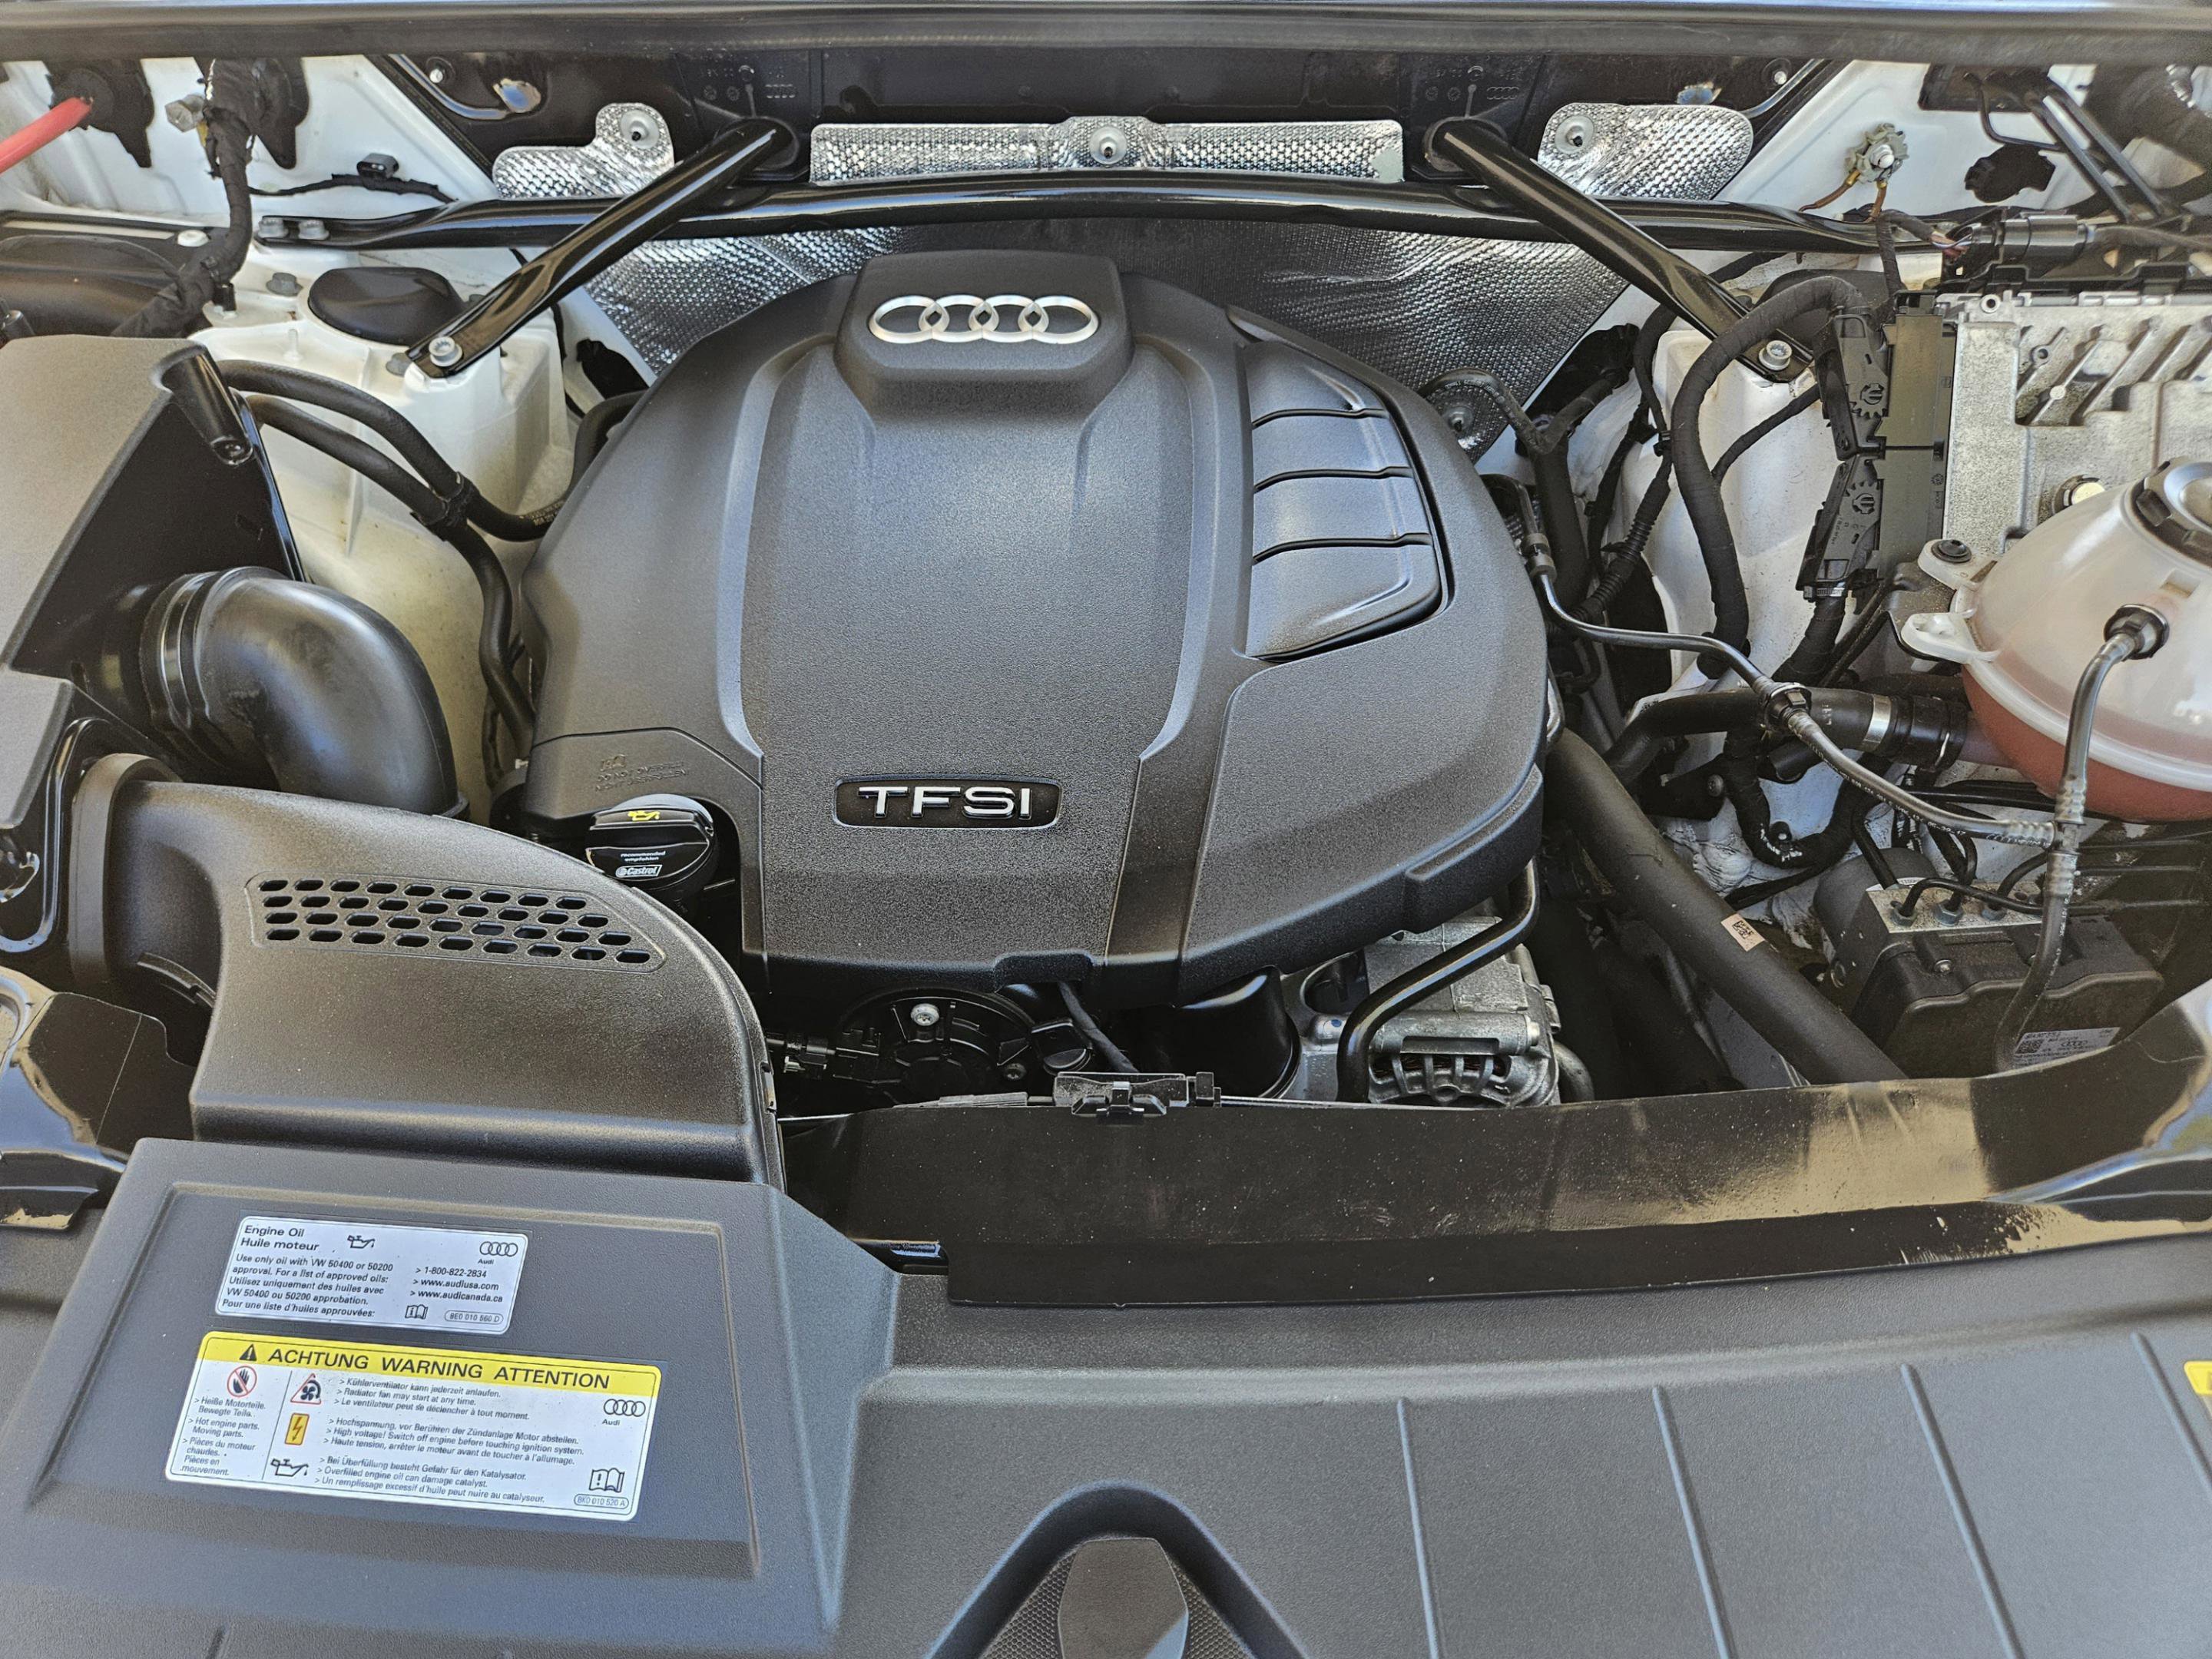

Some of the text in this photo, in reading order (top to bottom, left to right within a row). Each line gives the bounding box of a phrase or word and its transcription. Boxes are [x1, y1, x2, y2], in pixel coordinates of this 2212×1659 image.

[858, 786, 1032, 820] TFSI
[627, 866, 657, 876] Castrol
[245, 1225, 304, 1237] Engine Oil
[241, 1237, 319, 1250] Huile moteur
[237, 1253, 252, 1262] Use
[255, 1256, 273, 1265] only
[328, 1260, 353, 1269] 50400
[368, 1263, 393, 1271] 50200
[370, 1274, 388, 1283] oils:
[426, 1267, 486, 1277] 1-800-822-2834
[230, 1277, 260, 1286] Utilisez
[263, 1280, 315, 1289] uniquement
[335, 1283, 361, 1293] huiles
[421, 1280, 498, 1290] www.audiusa.com
[244, 1289, 270, 1297] 50400
[285, 1292, 310, 1300] 50200
[313, 1296, 367, 1304] approbation.
[419, 1291, 502, 1302] www.audicanada.ca
[222, 1299, 243, 1307] Pour
[263, 1302, 282, 1310] liste
[269, 1349, 608, 1388] ACHTUNG WARNING ATTENTION
[410, 1383, 429, 1392] kann
[430, 1385, 463, 1394] jederzeit
[465, 1389, 500, 1397] anlaufen.
[201, 1396, 223, 1406] Heiße
[344, 1388, 376, 1396] Radiator
[457, 1397, 475, 1406] time.
[210, 1419, 237, 1428] engine
[193, 1426, 221, 1437] Moving
[515, 1432, 539, 1441] Motor
[333, 1427, 352, 1436] High
[355, 1430, 386, 1439] voltage!
[388, 1432, 414, 1440] Switch
[458, 1437, 483, 1446] before
[486, 1441, 520, 1451] touching
[522, 1442, 551, 1452] ignition
[331, 1437, 354, 1445] Haute
[356, 1440, 386, 1449] tension,
[493, 1452, 523, 1460] toucher
[325, 1466, 363, 1476] Overfilled
[365, 1471, 391, 1480] engine
[422, 1475, 453, 1485] damage
[455, 1479, 487, 1488] catalyst.
[390, 1462, 419, 1471] besteht
[422, 1464, 448, 1473] Gefahr
[450, 1466, 462, 1475] für
[482, 1469, 525, 1480] Katalysator.
[322, 1476, 333, 1485] Un
[336, 1479, 382, 1490] remplissage
[502, 1493, 544, 1502] catalyseur.
